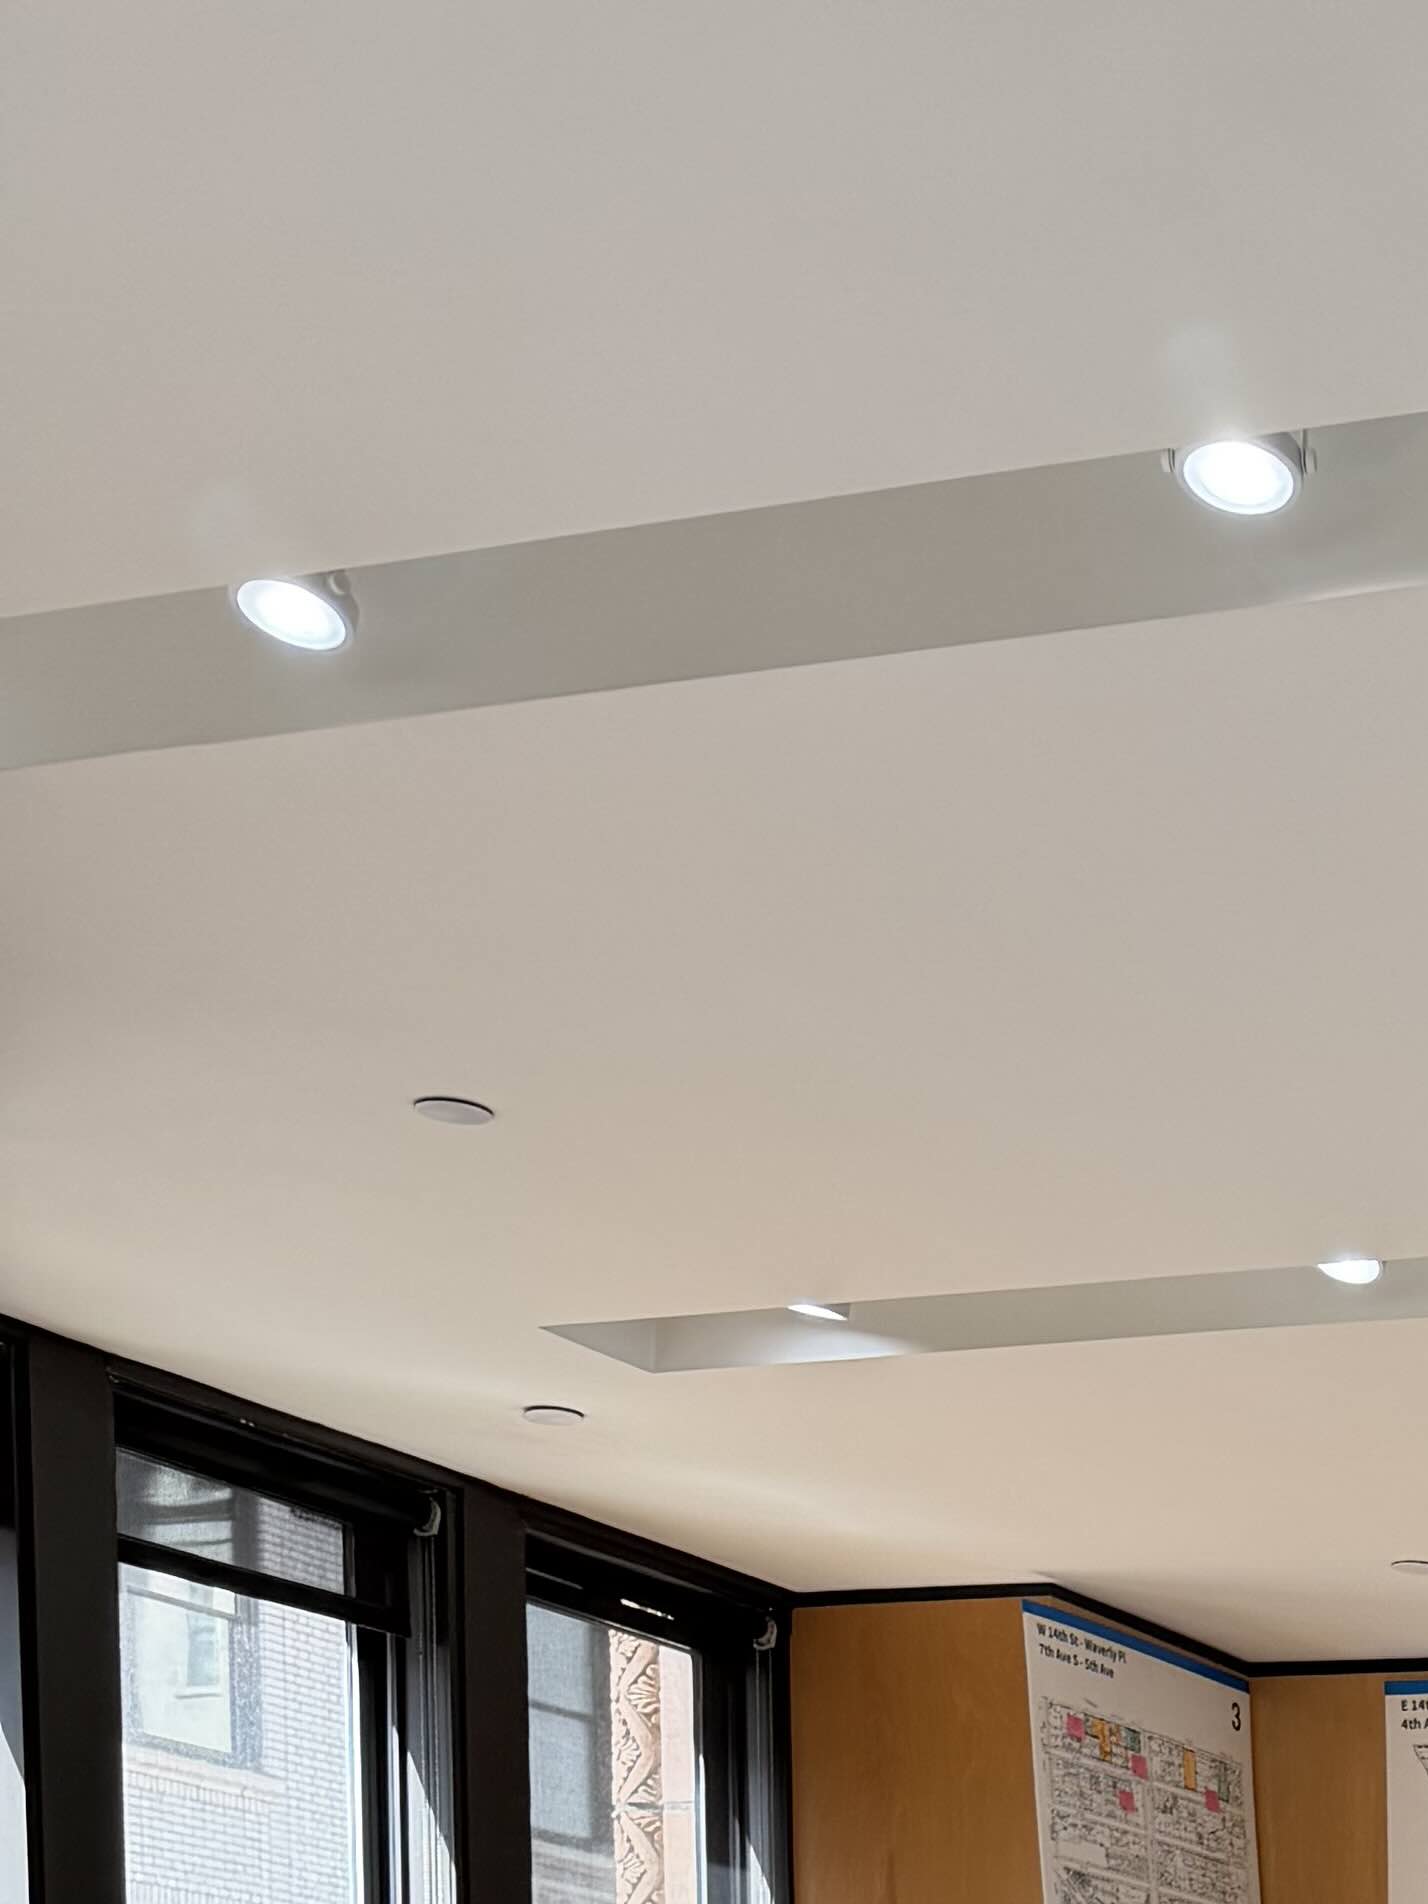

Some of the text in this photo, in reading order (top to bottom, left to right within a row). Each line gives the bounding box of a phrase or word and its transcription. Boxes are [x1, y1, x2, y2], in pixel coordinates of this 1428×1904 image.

[1036, 1623, 1127, 1663] W 14th St Waverly Pl
[1231, 1702, 1241, 1731] 3
[1401, 1701, 1409, 1712] E
[1401, 1717, 1421, 1730] 4th
